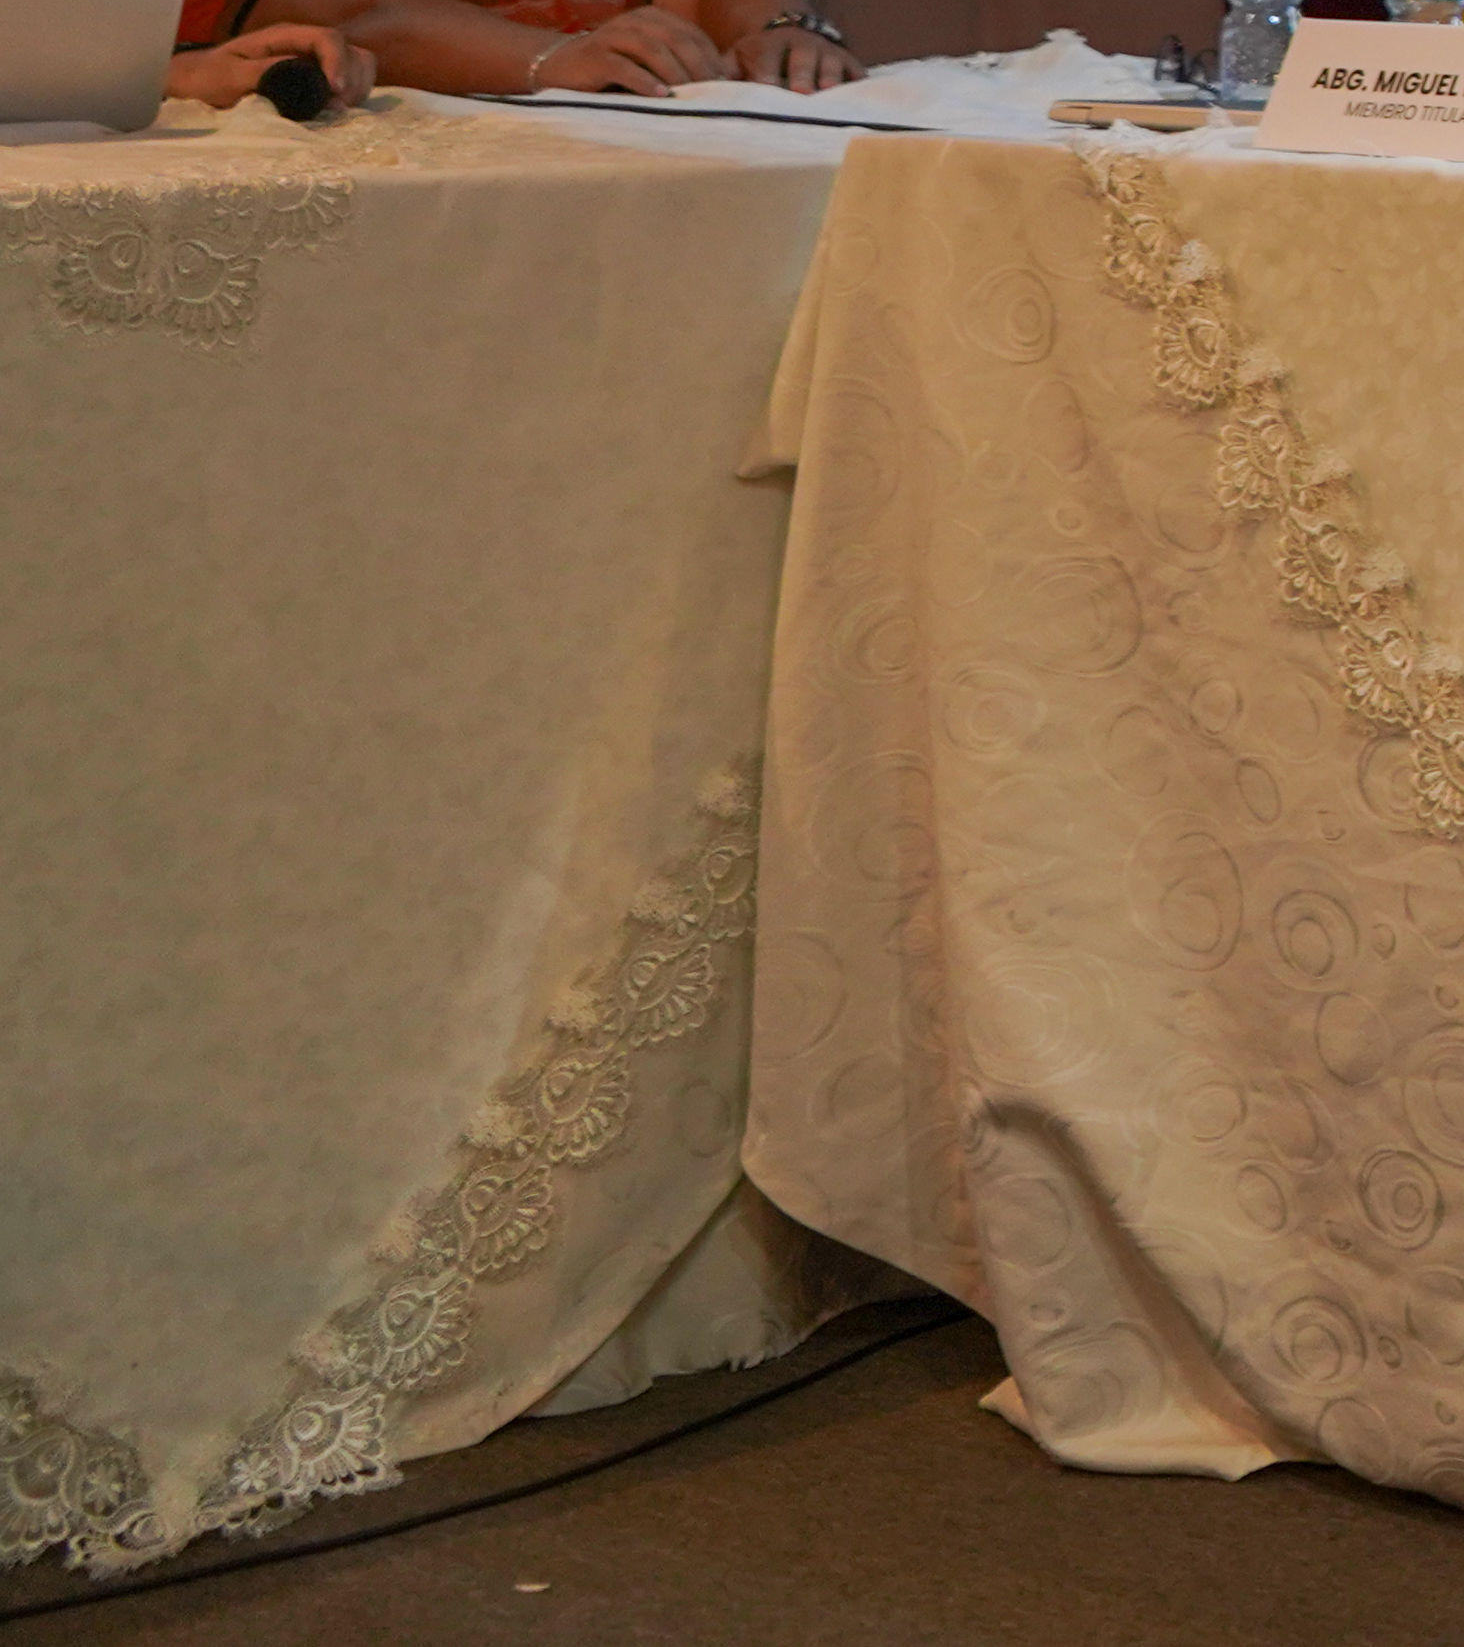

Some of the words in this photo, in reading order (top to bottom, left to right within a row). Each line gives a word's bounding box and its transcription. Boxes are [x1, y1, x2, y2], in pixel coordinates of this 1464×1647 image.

[1312, 67, 1367, 92] ABG.
[1373, 70, 1459, 97] MIGUEL
[1344, 101, 1418, 121] MIEMBRO
